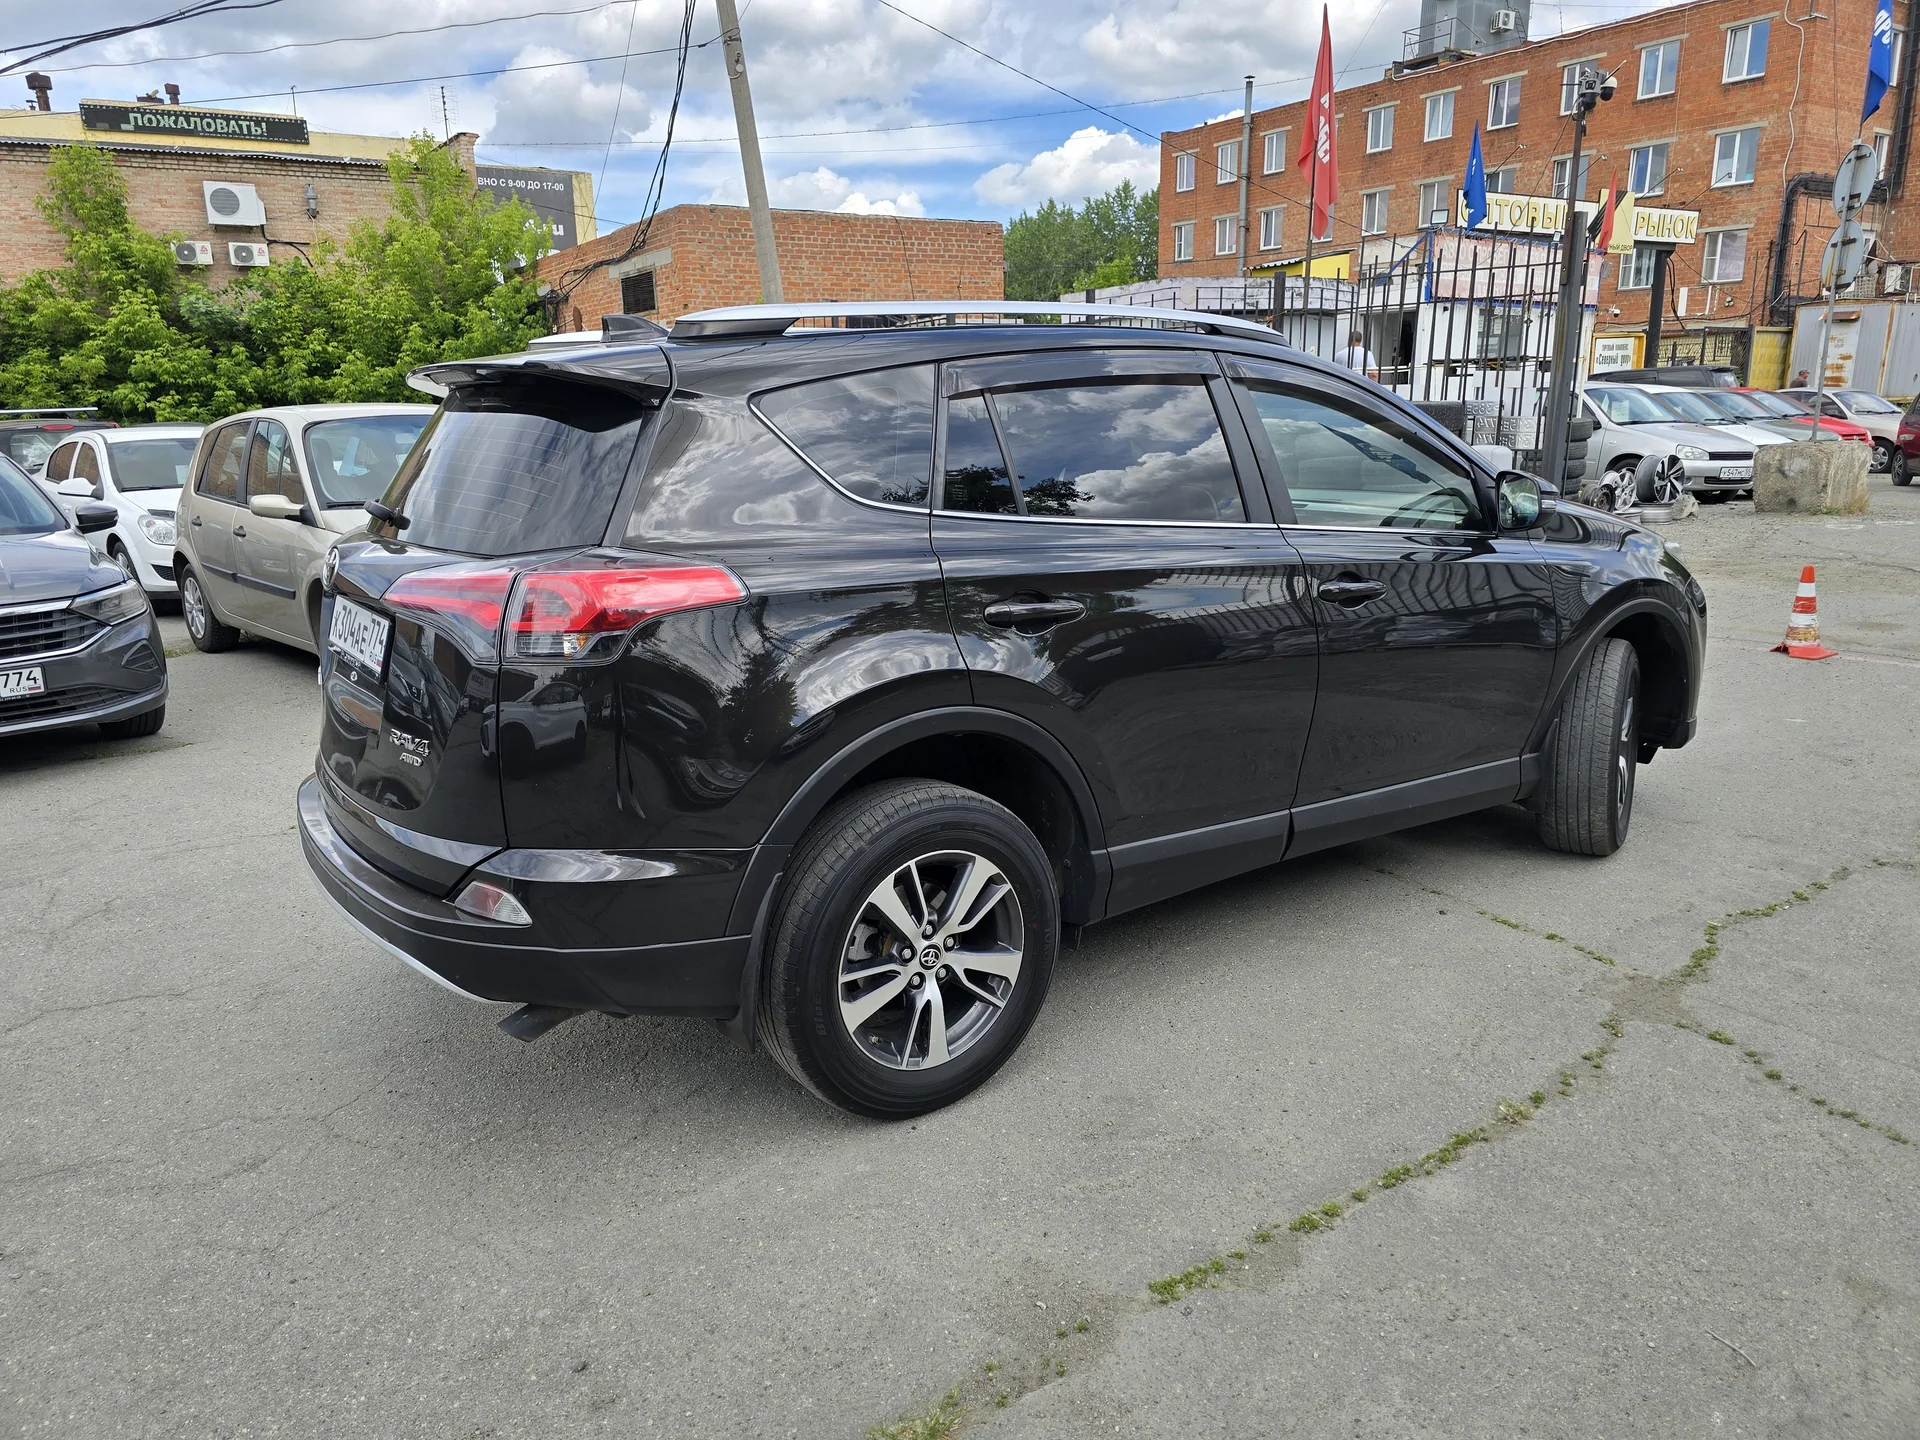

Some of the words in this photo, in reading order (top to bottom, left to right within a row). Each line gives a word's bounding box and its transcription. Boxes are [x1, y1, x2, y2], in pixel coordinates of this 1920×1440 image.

[128, 112, 268, 136] ПОЖАЛОВАТЬ!
[508, 179, 526, 188] 9-00
[527, 180, 541, 190] ДО
[542, 182, 564, 191] 17-00
[1634, 211, 1698, 240] РЫНОК
[390, 728, 430, 757] RAV4
[399, 752, 423, 767] AWD
